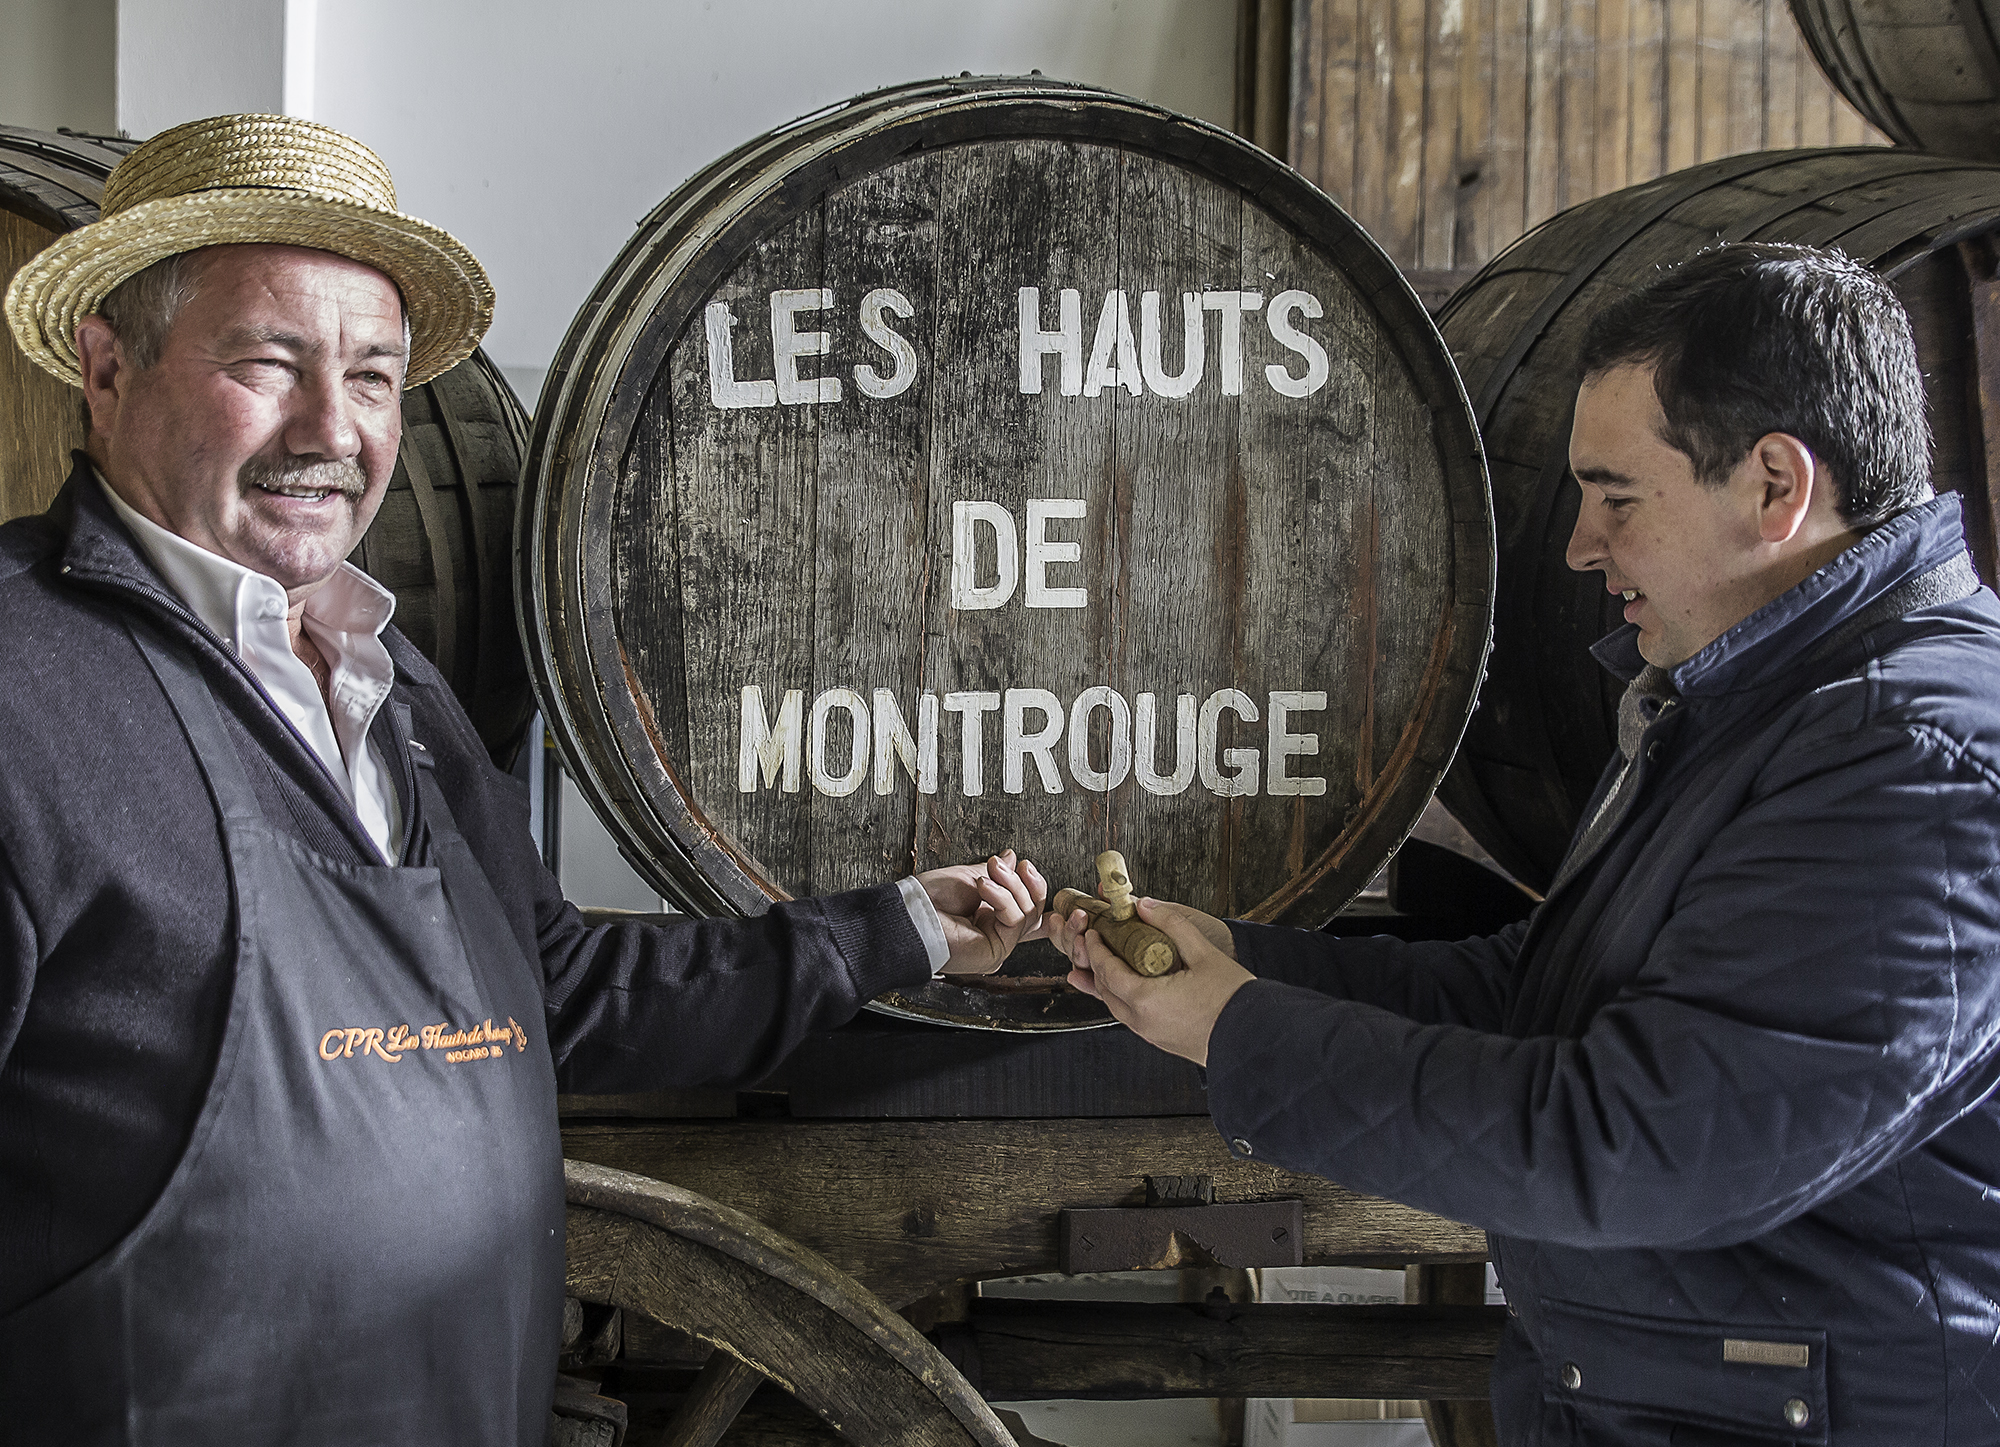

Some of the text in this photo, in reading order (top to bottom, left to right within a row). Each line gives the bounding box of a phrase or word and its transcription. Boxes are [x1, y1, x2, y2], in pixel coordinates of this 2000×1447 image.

[705, 286, 1329, 410] LES HAUTS
[951, 499, 1088, 611] DE
[738, 685, 1328, 797] MONTROUGE
[319, 1027, 402, 1063] CPR
[445, 1046, 490, 1064] NOGARO
